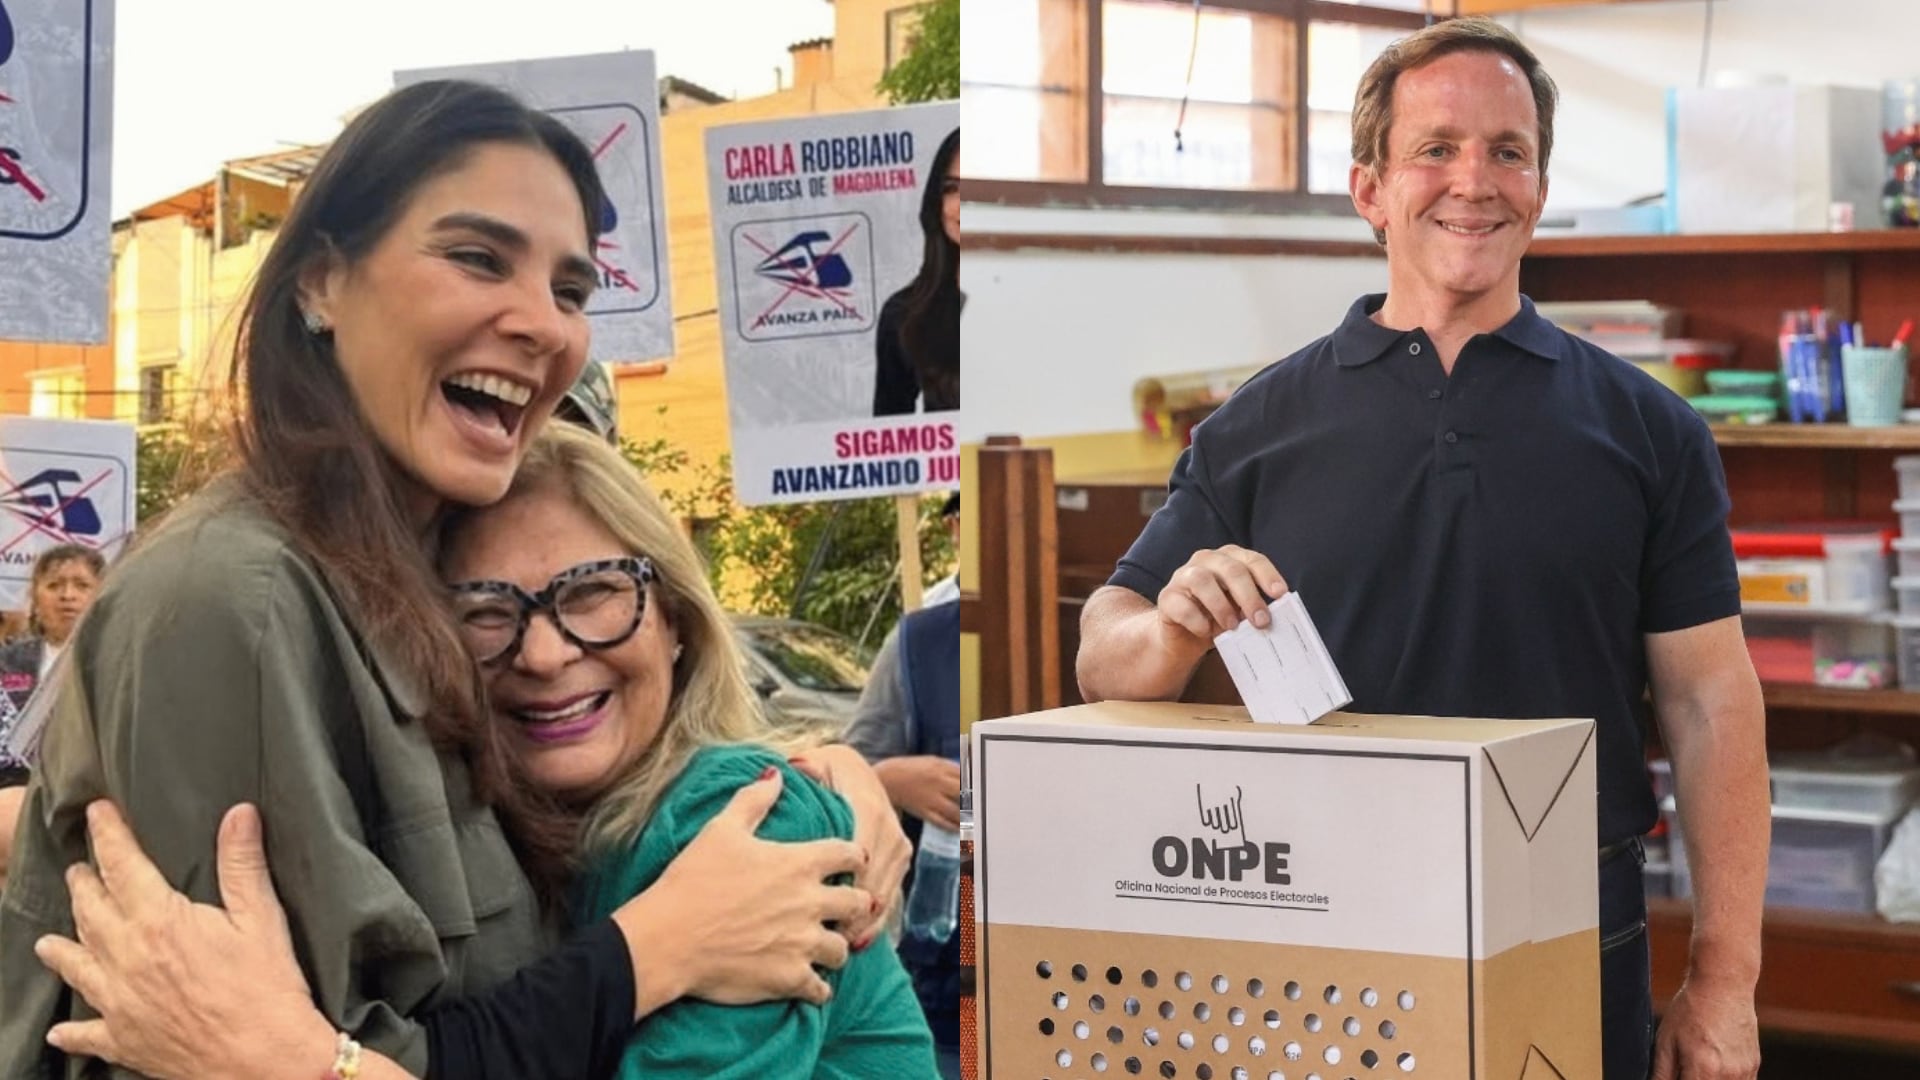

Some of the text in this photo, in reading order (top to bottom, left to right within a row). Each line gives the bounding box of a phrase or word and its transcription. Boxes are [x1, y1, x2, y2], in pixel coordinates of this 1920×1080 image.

[725, 131, 914, 181] CARLA ROBBIANO
[727, 169, 916, 205] ALCALDESA DE MAGDALENA
[757, 311, 818, 326] AVANZA
[835, 424, 954, 458] SIGAMOS
[772, 456, 960, 494] AVANZANDO JU
[1152, 835, 1291, 885] ONPE
[1115, 880, 1330, 905] Oficina Nacional de Procesos Electorales
